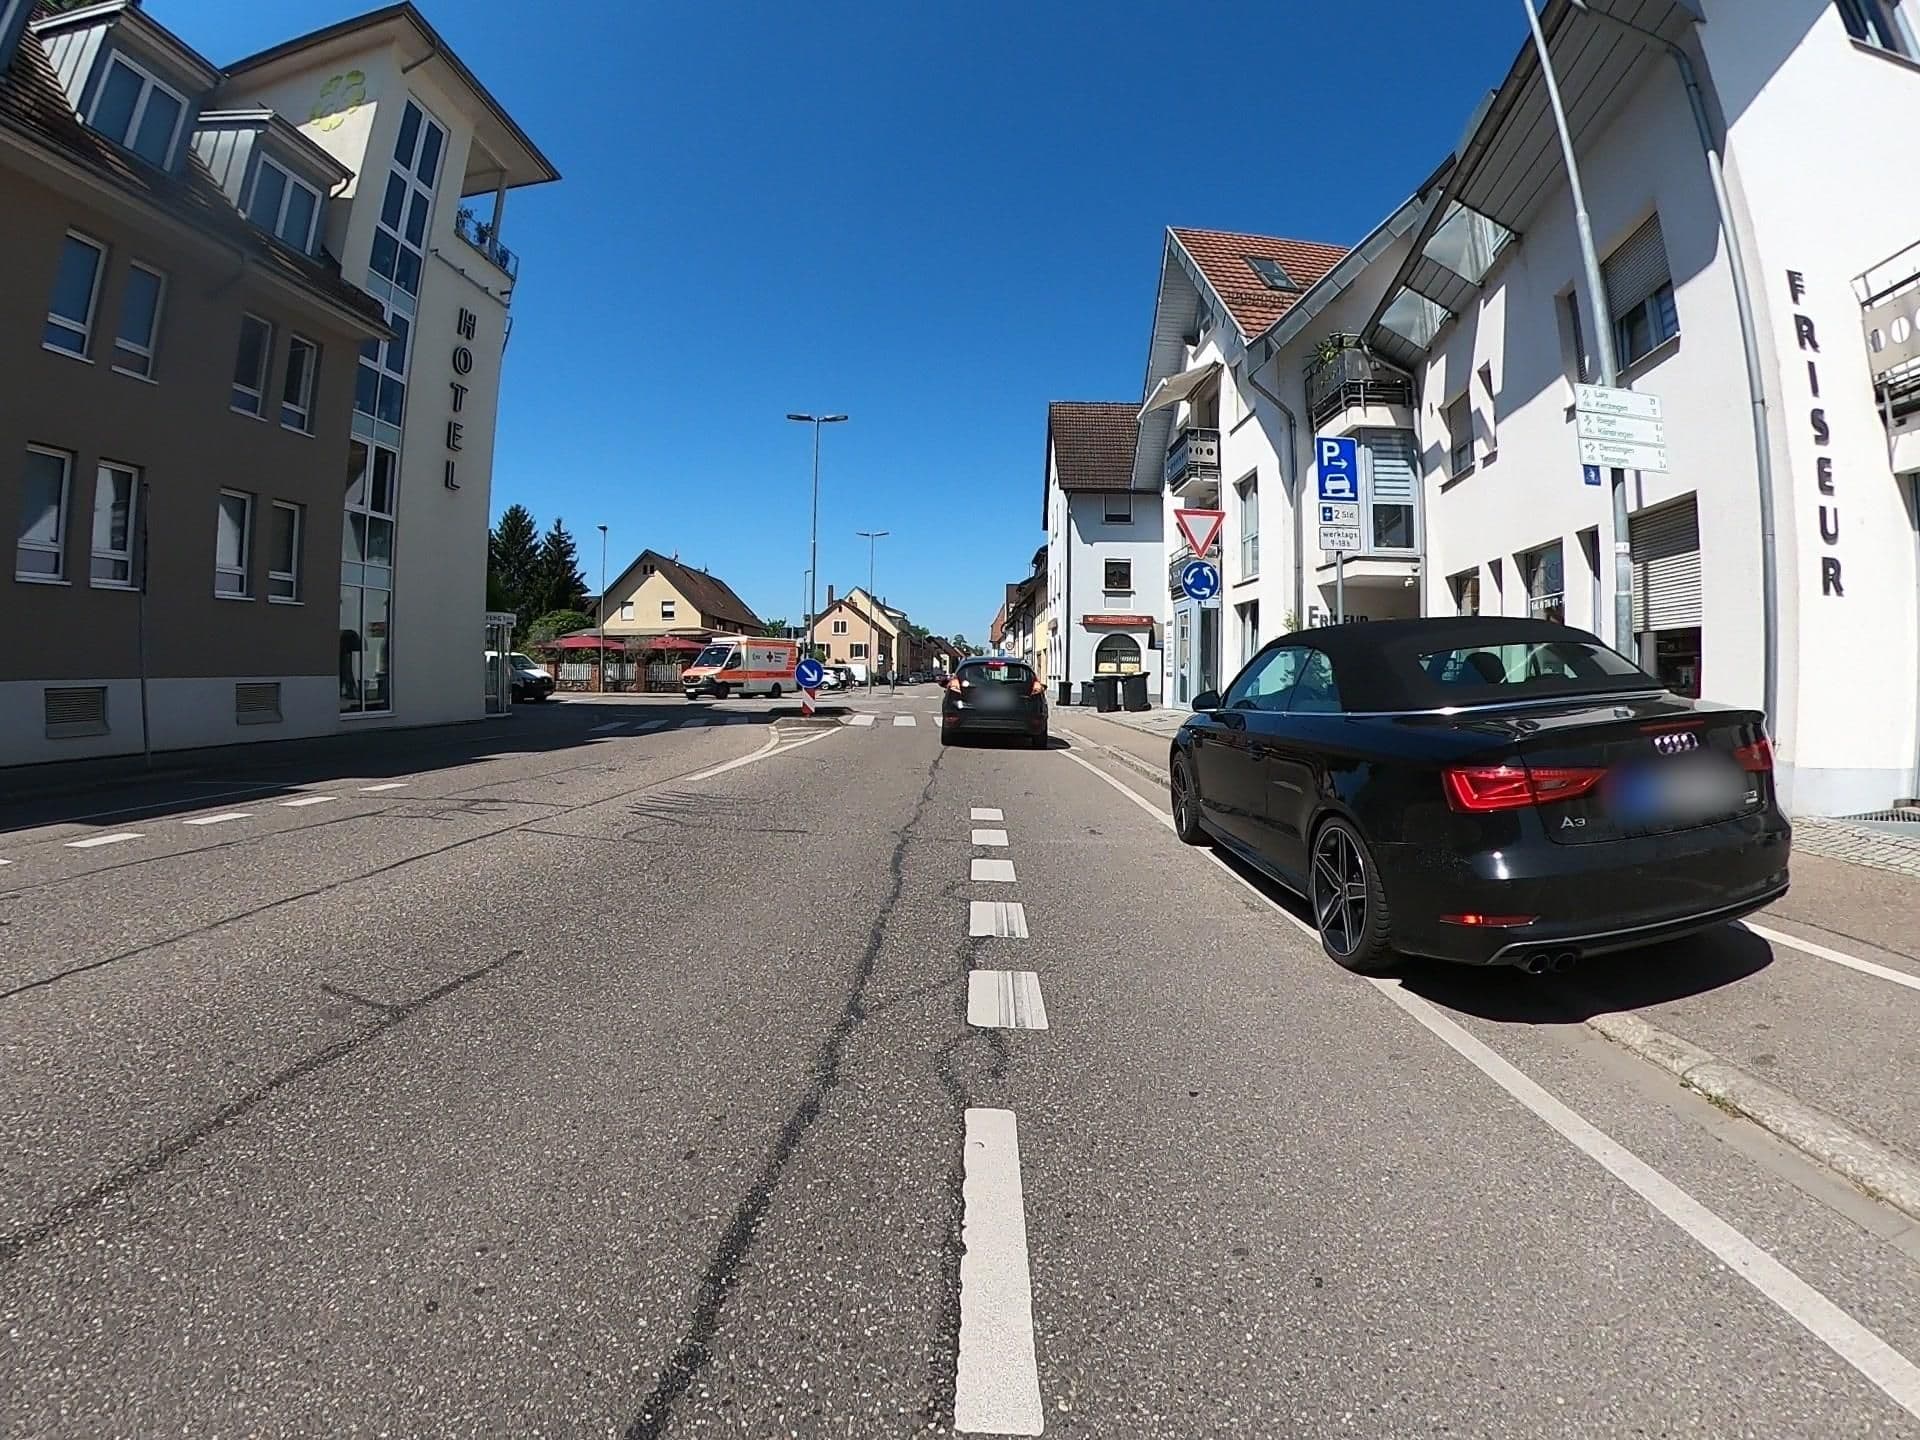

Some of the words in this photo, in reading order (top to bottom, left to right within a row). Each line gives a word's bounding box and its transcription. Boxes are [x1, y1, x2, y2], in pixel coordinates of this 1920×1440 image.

[444, 306, 477, 491] HOTEL
[1786, 269, 1844, 597] FRISEUR
[1323, 440, 1340, 466] P
[1334, 509, 1340, 520] 2
[1560, 816, 1586, 829] A3
